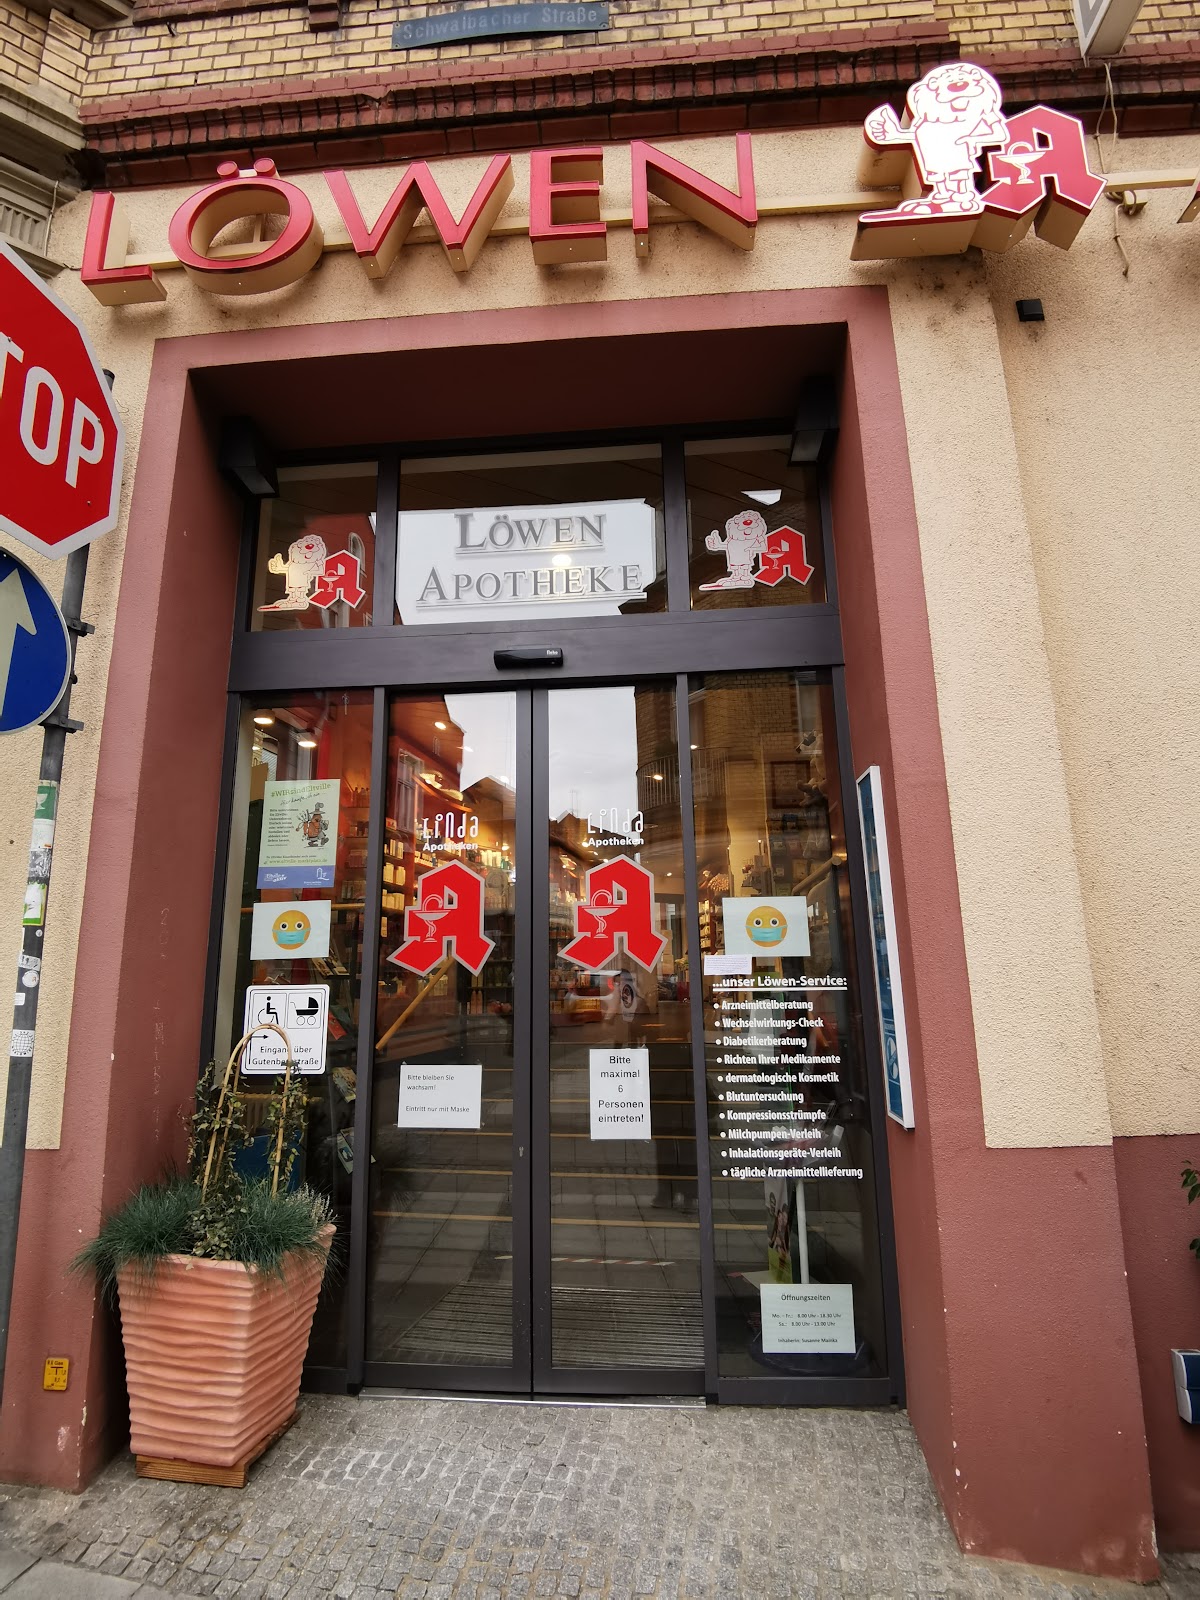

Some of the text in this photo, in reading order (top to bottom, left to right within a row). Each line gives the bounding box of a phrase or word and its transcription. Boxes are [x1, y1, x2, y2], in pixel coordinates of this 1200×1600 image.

[402, 6, 598, 41] Schwalbacher Straße
[81, 132, 758, 290] LÖWEN
[454, 512, 606, 548] LÖWEN
[418, 563, 644, 602] APOTHEKE
[422, 842, 478, 852] Apotheken
[588, 837, 644, 848] Apotheken
[758, 975, 848, 987] Löwen-Service:
[721, 1000, 814, 1010] Arzneimittelberatung
[722, 1017, 824, 1029] Wechselwirkungs-Check
[723, 1036, 808, 1048] Diabetikerberatung
[260, 1046, 289, 1054] Eingan
[609, 1055, 631, 1064] Bitte
[724, 1054, 841, 1064] Richten Ihrer Medikamente
[600, 1069, 641, 1078] maximal
[725, 1071, 840, 1085] dermatologische Kosmetik
[617, 1084, 624, 1093] 6
[726, 1091, 805, 1103] Blutuntersuchung
[598, 1099, 644, 1109] Personen
[598, 1113, 644, 1123] eintreten!
[727, 1109, 827, 1122] Kompressionsstrümpfe
[728, 1128, 822, 1141] Milchpumpen-Verleih
[729, 1147, 842, 1160] Inhalationsgeräte-Verleih
[730, 1166, 864, 1179] tägliche Arzneimittellieferung
[781, 1293, 831, 1302] Öffnungszeiten
